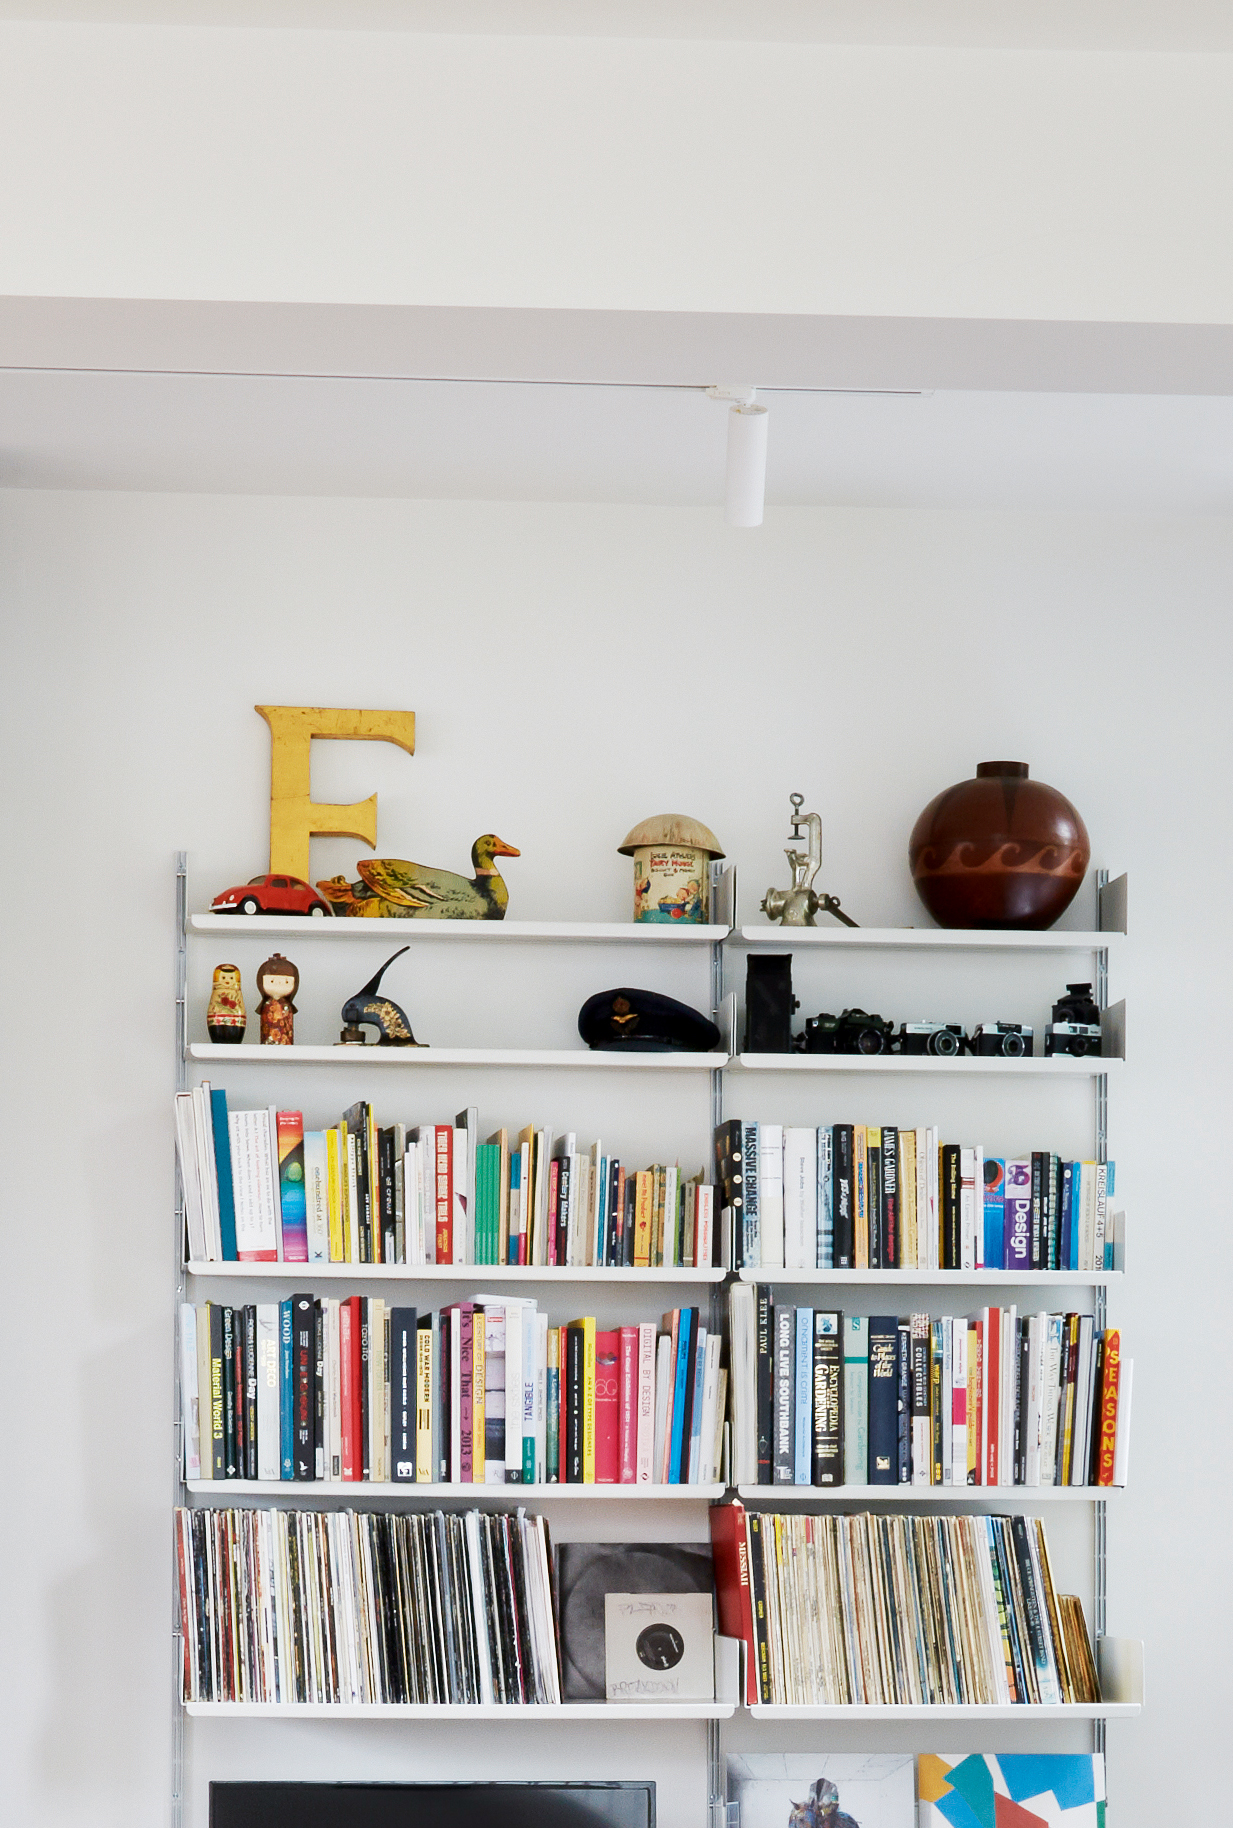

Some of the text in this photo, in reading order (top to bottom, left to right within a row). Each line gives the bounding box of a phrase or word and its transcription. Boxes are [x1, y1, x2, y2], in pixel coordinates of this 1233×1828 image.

[744, 1127, 758, 1216] MASSIVE CHANGE
[883, 1129, 896, 1194] JAMES GARDNER
[917, 1151, 925, 1174] Objects
[559, 1171, 569, 1227] Century Makers
[1096, 1168, 1106, 1238] KREISLAUF 4+5
[1010, 1199, 1030, 1259] Design
[223, 1309, 233, 1360] Green Design
[282, 1310, 291, 1344] WOOD
[759, 1298, 768, 1354] PAUL KLEE
[246, 1378, 257, 1400] Day
[266, 1339, 276, 1388] ART DECO
[315, 1360, 324, 1377] Day
[461, 1310, 472, 1456] It's Nice That 2013
[474, 1364, 485, 1404] DESIGN
[642, 1328, 652, 1417] DIGITAL BY DESIGN
[779, 1313, 790, 1454] LONG LIVE SOUTHBANK
[915, 1347, 923, 1407] COLLECTIBLES
[1045, 1346, 1058, 1437] THE WAY THINGS WORK
[212, 1358, 223, 1439] Material World 3
[524, 1382, 534, 1422] TANGIBLE
[814, 1363, 829, 1432] GARDENING
[829, 1365, 840, 1432] ENCYCLOPEDIA
[967, 1376, 975, 1429] beginner's guide
[1102, 1350, 1120, 1468] SEASONS
[855, 1426, 866, 1471] Gardening
[738, 1541, 749, 1586] MESSIAH
